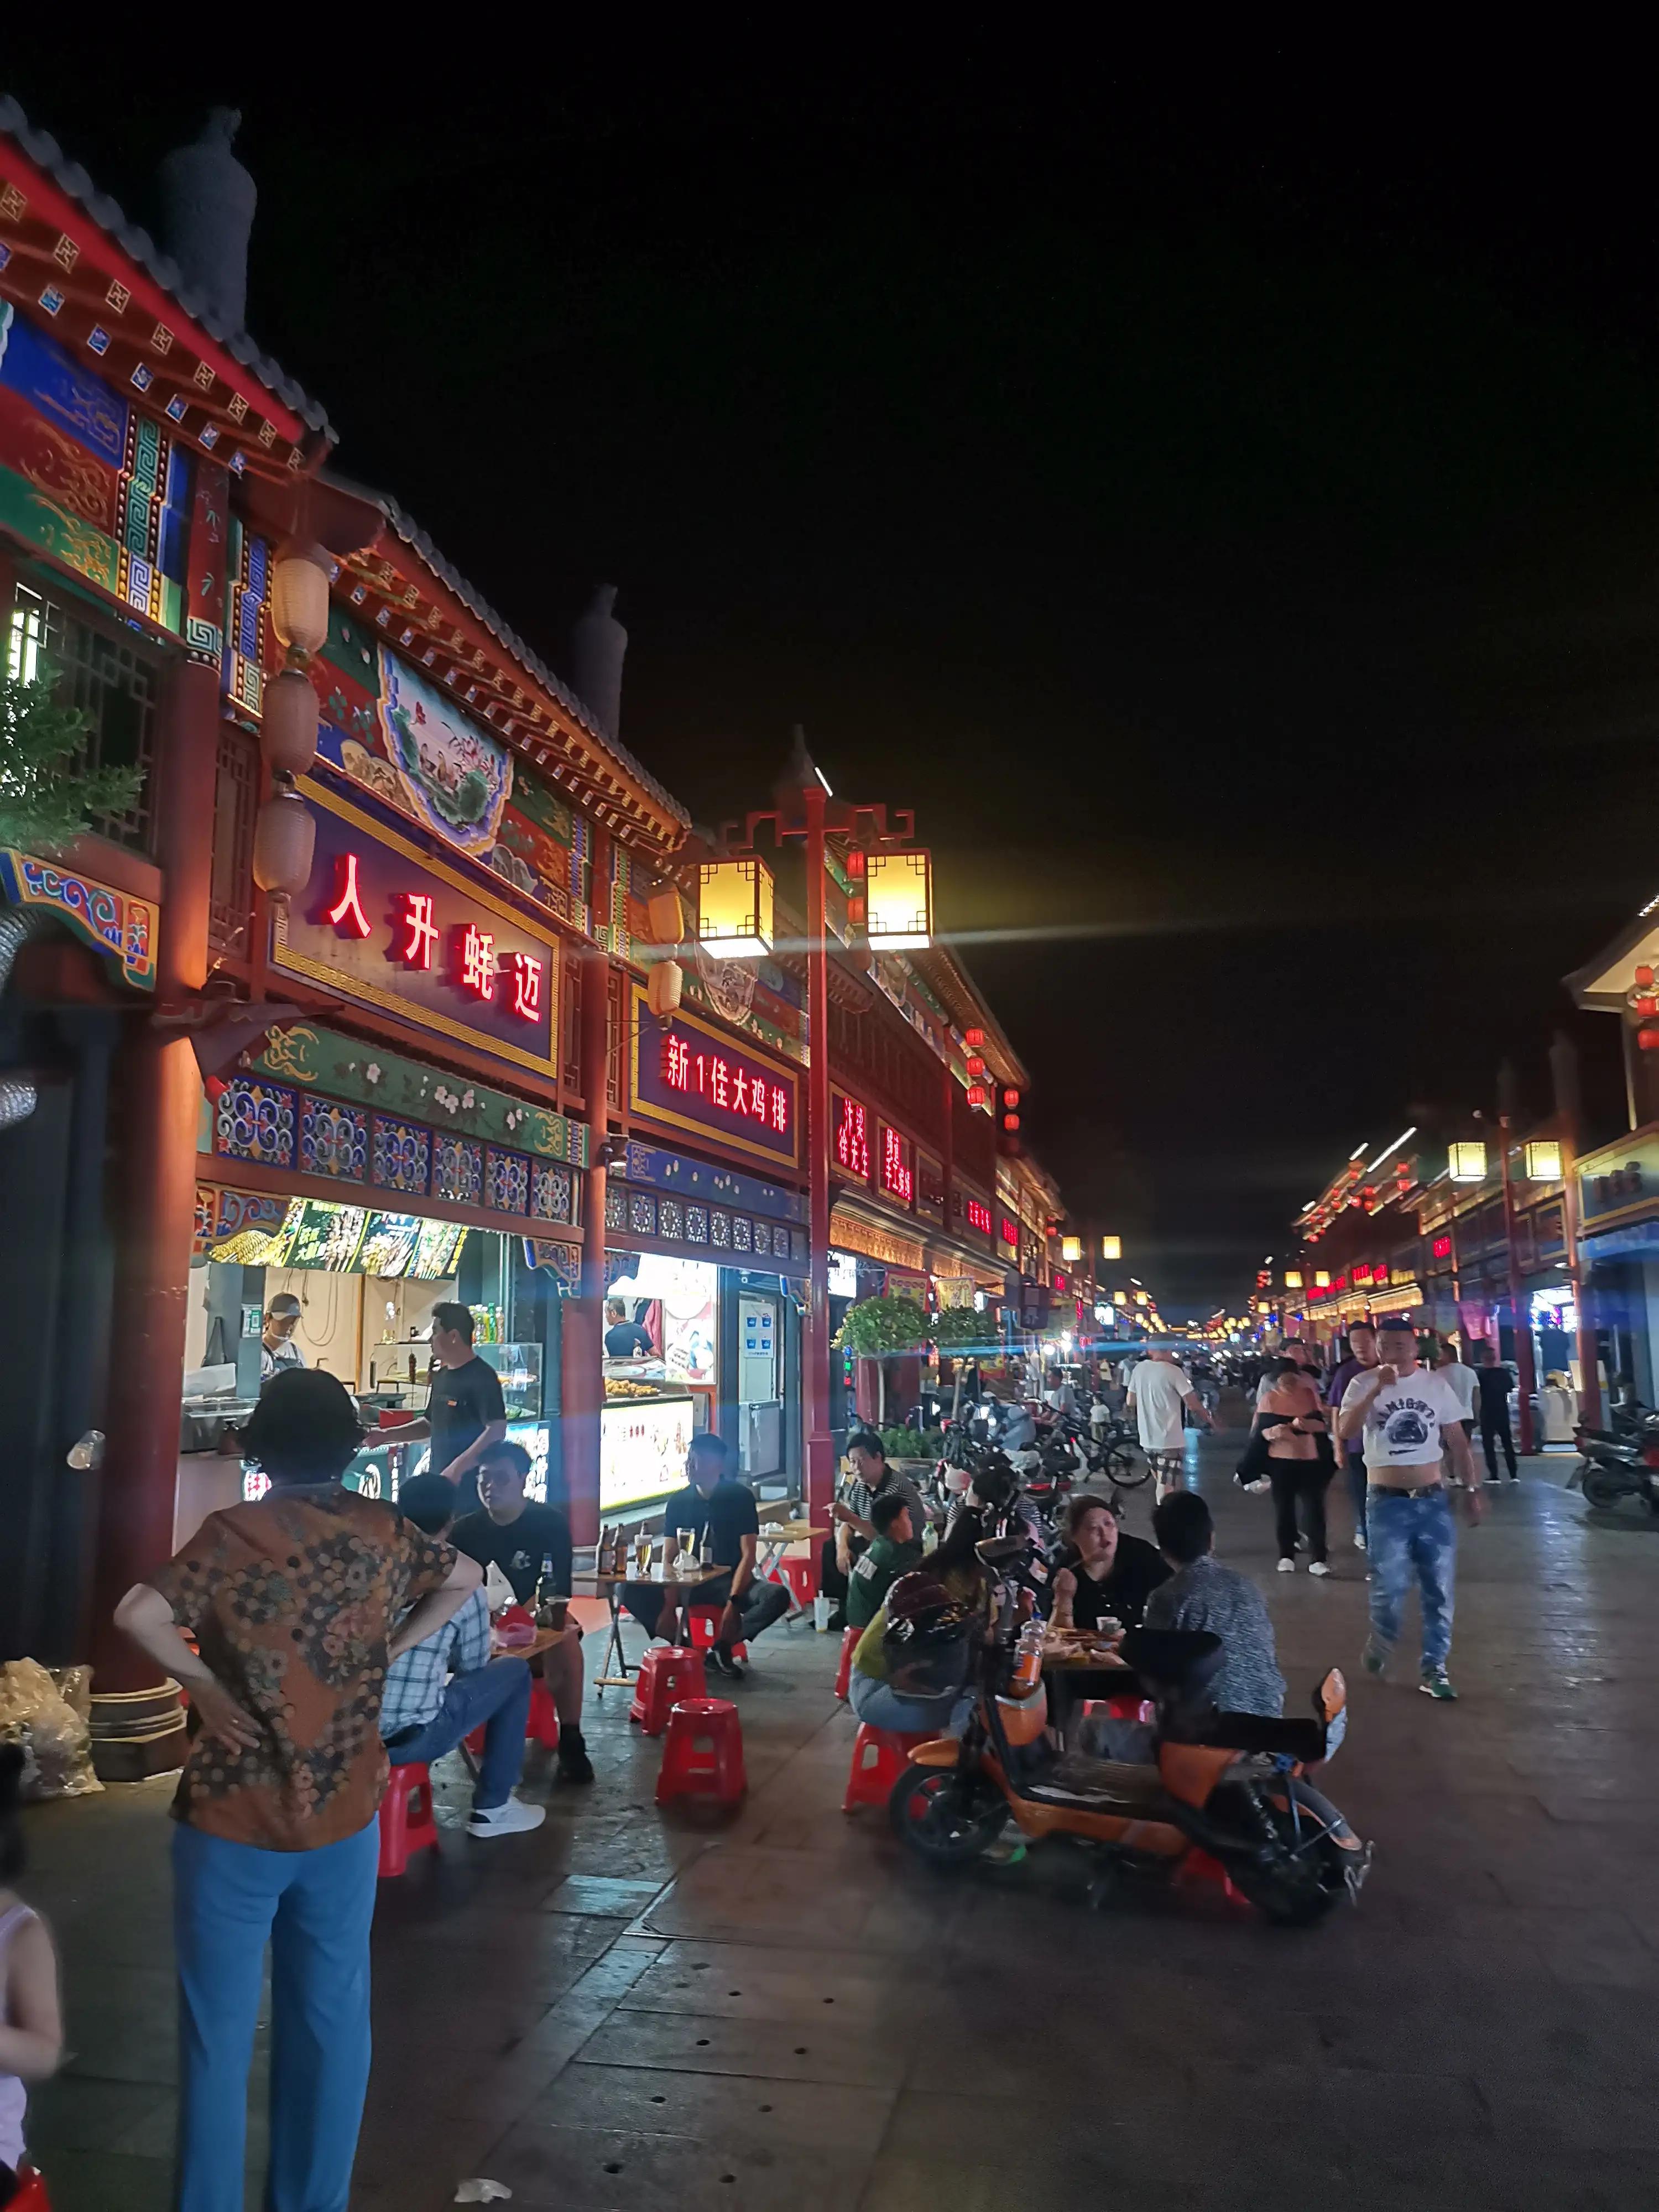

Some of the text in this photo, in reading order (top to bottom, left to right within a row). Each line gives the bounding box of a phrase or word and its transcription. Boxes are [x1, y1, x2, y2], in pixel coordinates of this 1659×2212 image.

[667, 1035, 786, 1133] 新1佳大鸡排
